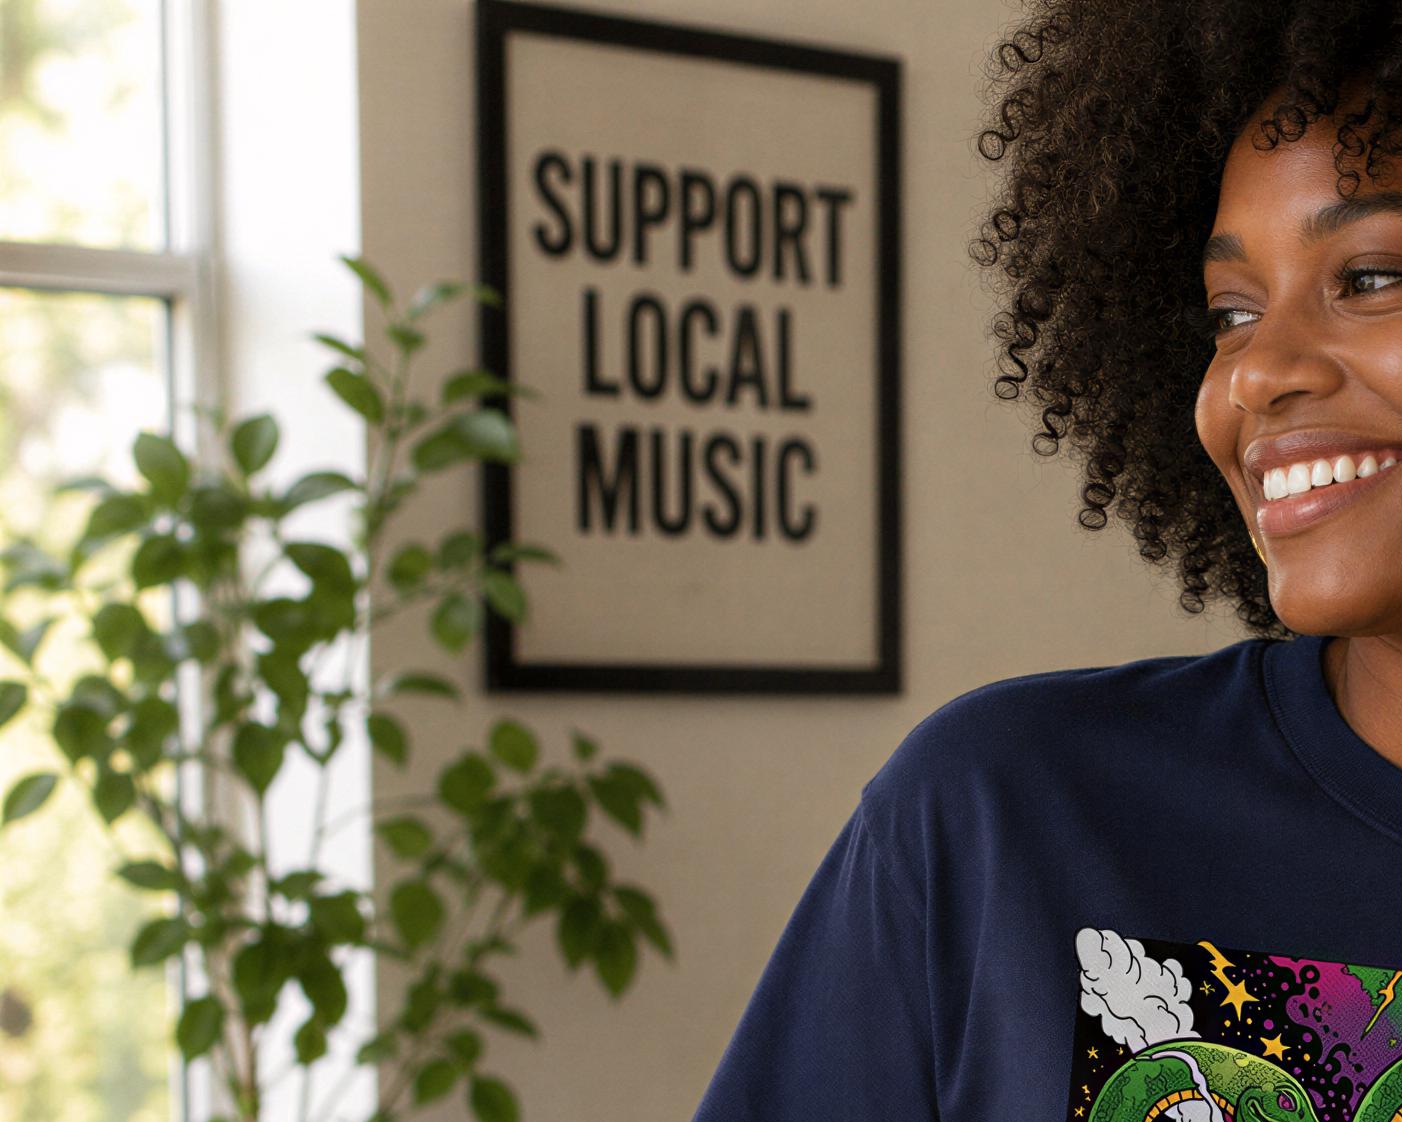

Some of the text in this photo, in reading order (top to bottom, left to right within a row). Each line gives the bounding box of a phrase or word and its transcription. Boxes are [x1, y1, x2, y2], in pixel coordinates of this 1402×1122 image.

[533, 150, 853, 289] SUPPORT
[582, 288, 814, 412] LOCAL
[577, 422, 817, 544] MUSIC
